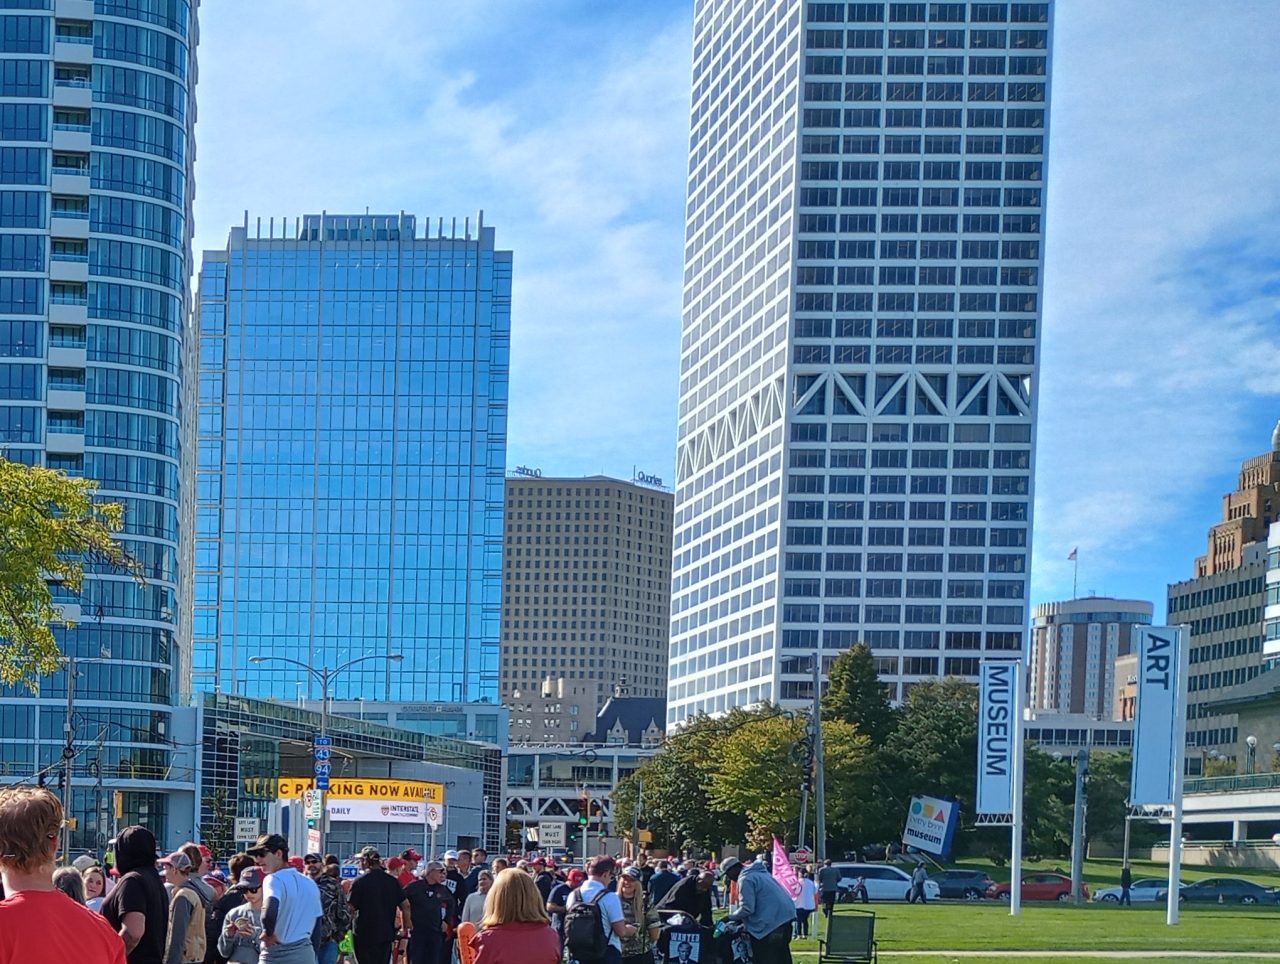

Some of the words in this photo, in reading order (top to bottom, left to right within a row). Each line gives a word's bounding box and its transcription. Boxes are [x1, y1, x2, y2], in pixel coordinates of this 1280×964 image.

[1146, 634, 1170, 690] ART
[985, 665, 1009, 776] MUSEUM
[316, 749, 329, 758] 43
[315, 765, 328, 774] 94
[295, 783, 364, 795] PAKING
[369, 784, 400, 797] NOW
[331, 807, 351, 815] DAILY
[907, 828, 942, 845] museum
[671, 932, 700, 942] WANTED
